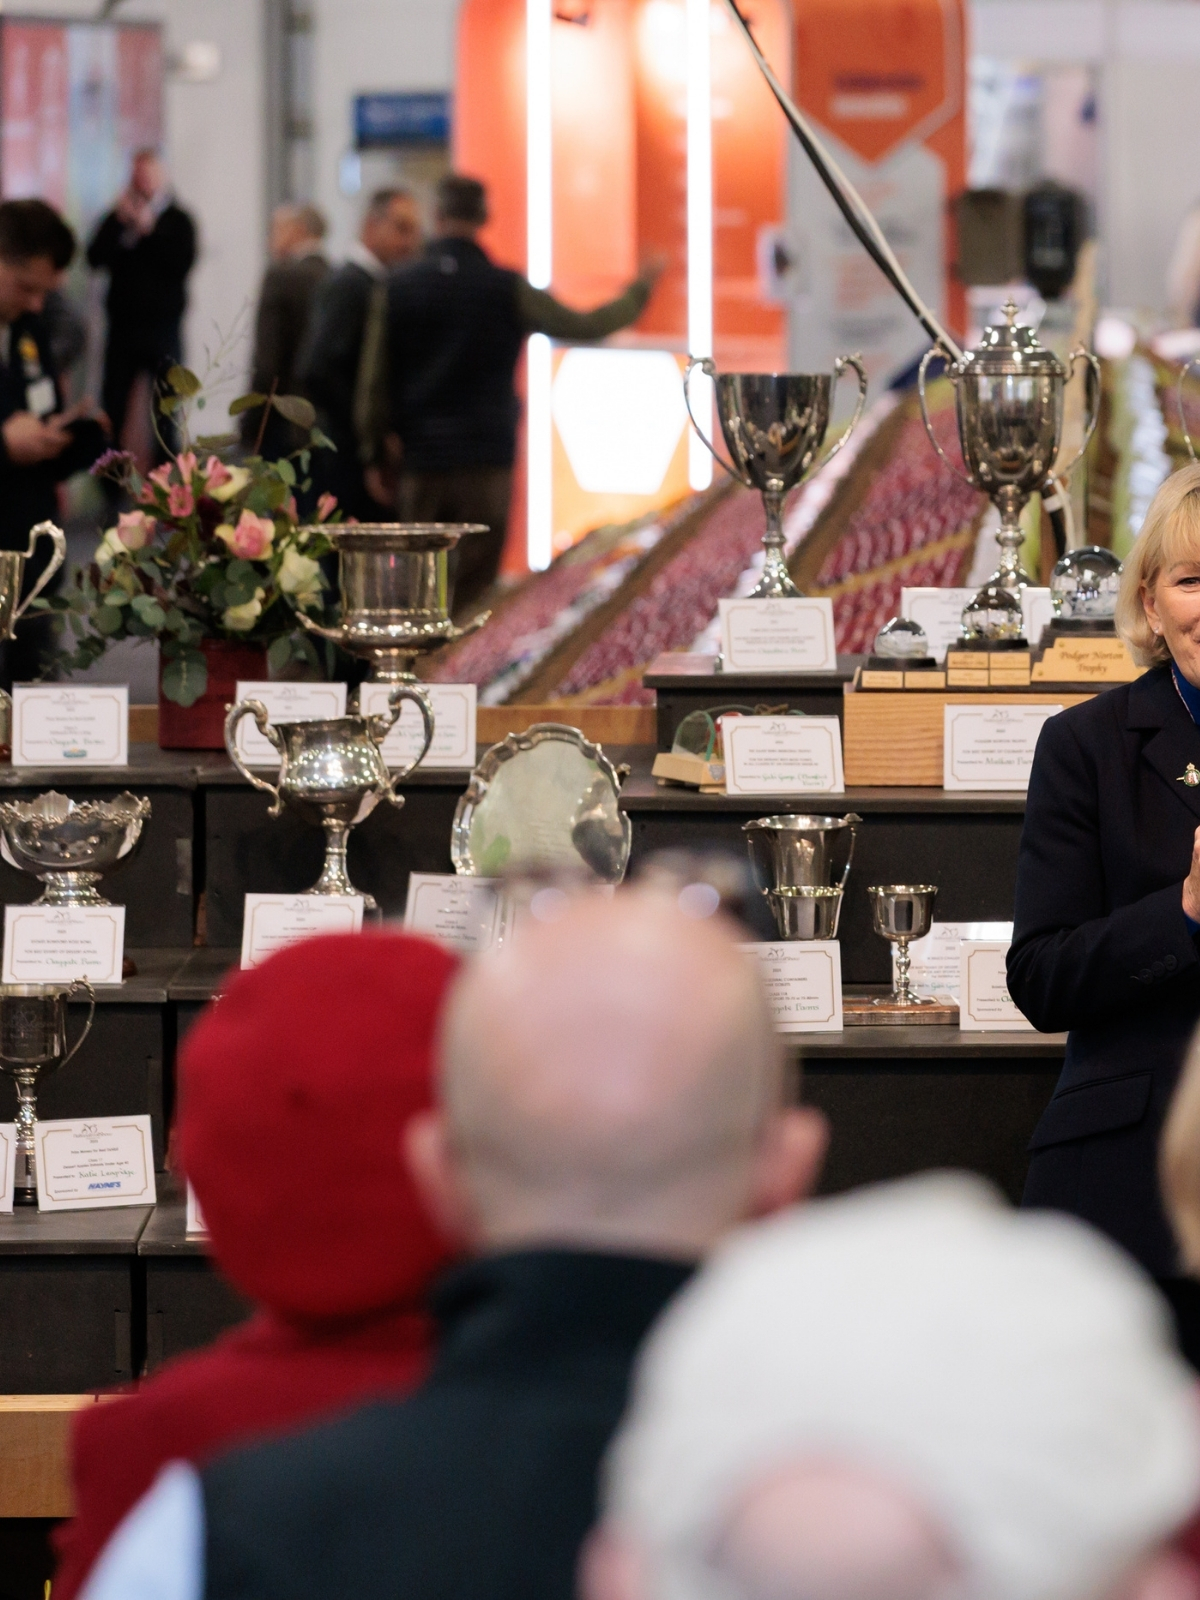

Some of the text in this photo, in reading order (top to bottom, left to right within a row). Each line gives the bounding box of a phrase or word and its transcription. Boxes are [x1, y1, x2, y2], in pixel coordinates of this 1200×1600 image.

[1060, 651, 1123, 662] Podger Norton
[1077, 662, 1107, 676] Trophy
